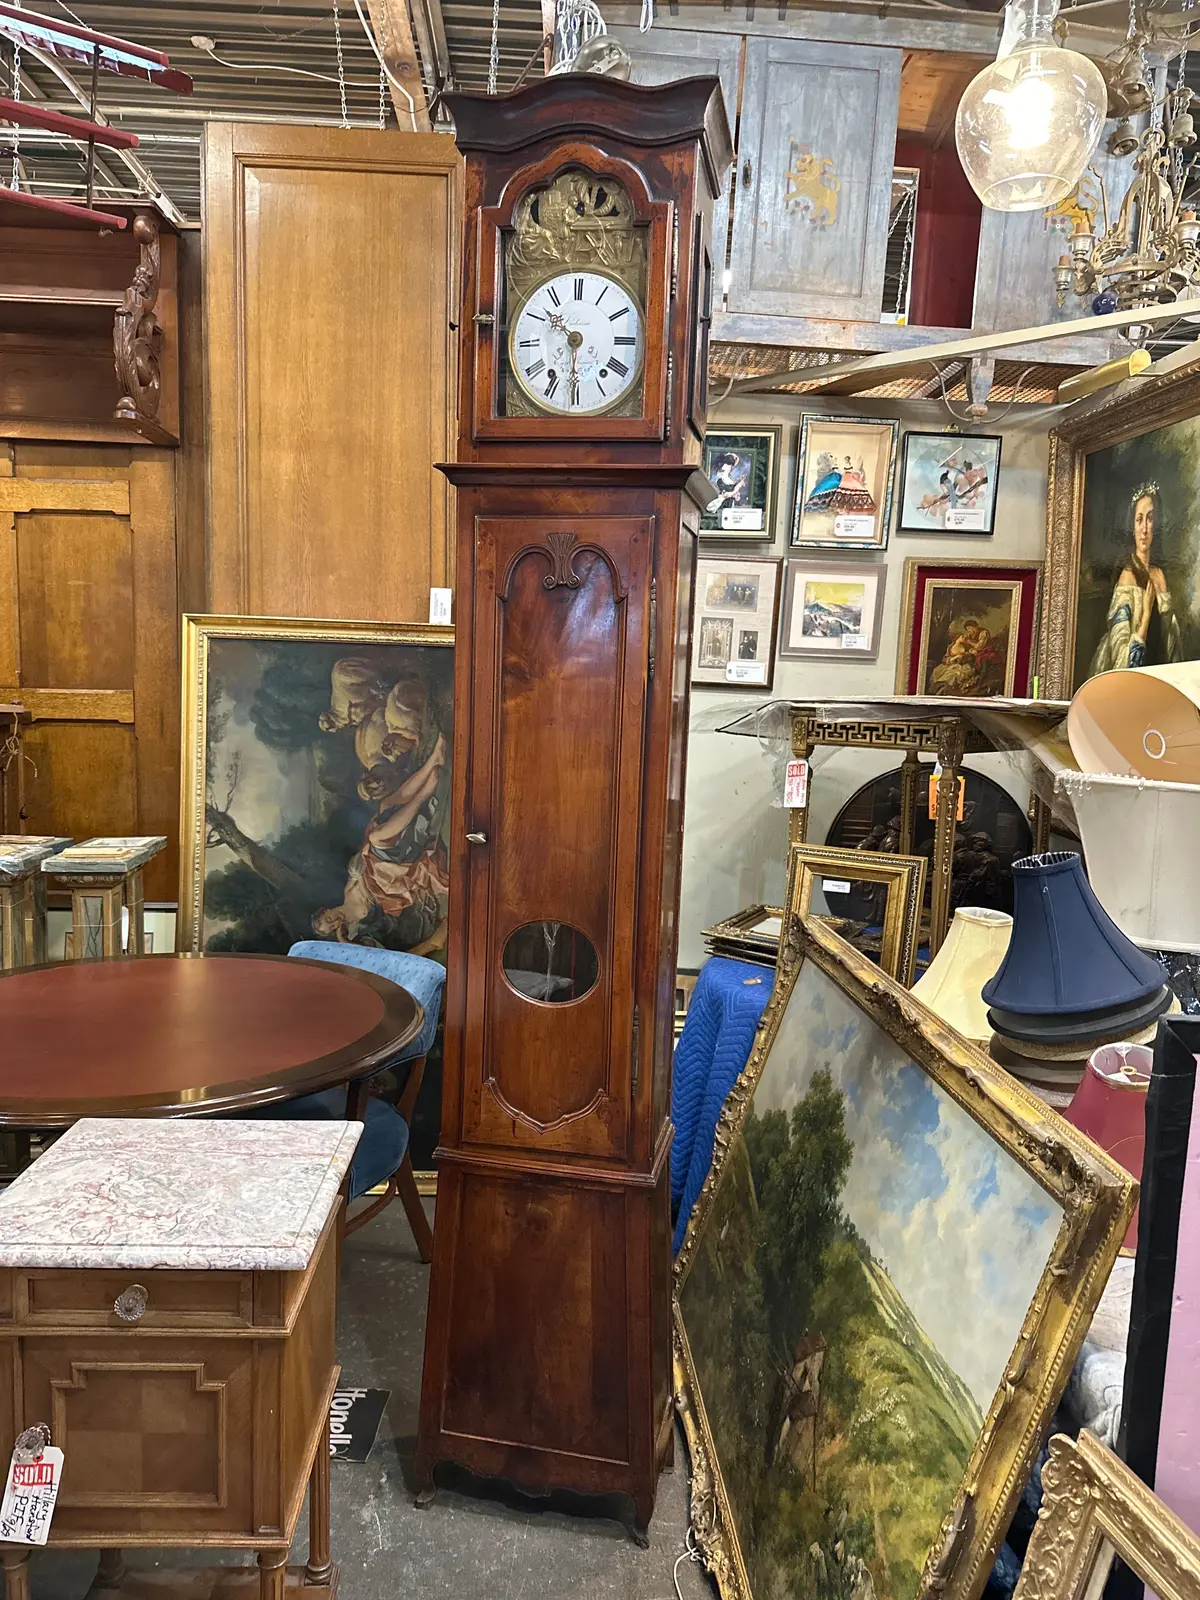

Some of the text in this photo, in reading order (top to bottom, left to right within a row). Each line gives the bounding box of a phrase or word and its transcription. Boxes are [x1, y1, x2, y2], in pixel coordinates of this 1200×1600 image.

[595, 286, 608, 306] I
[608, 307, 630, 322] II
[614, 336, 636, 346] III
[788, 763, 805, 777] SOLD
[13, 1464, 54, 1485] SOLD
[38, 1481, 58, 1521] Hillary
